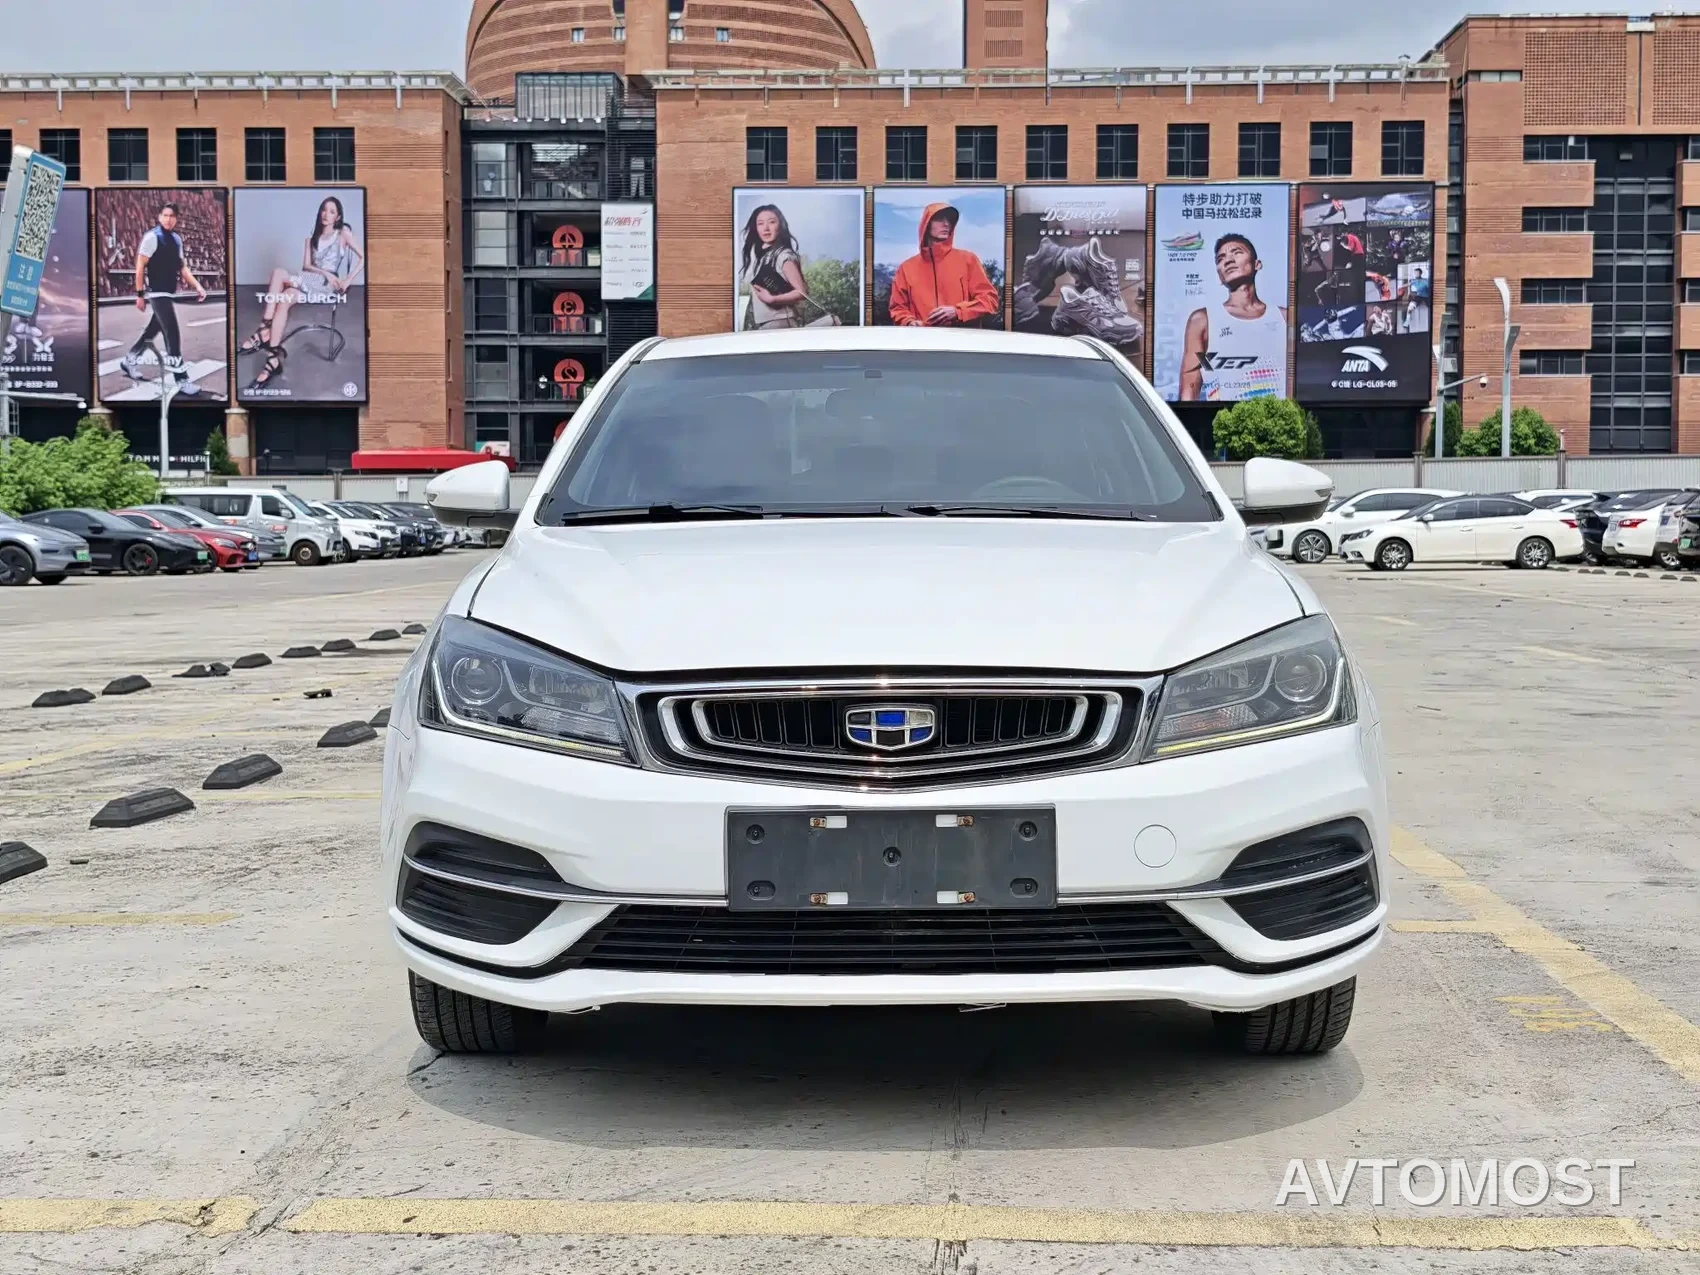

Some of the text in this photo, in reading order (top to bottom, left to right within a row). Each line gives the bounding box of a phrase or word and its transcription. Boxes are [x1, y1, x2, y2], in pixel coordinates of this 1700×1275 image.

[1182, 192, 1263, 206] 特步助力打破
[1182, 207, 1263, 220] 中国马拉松纪录
[255, 291, 347, 304] TORY BURCH
[129, 355, 183, 368] saucny
[1195, 352, 1259, 372] XTEP
[1341, 359, 1371, 372] ANTA
[129, 454, 161, 464] TOMM
